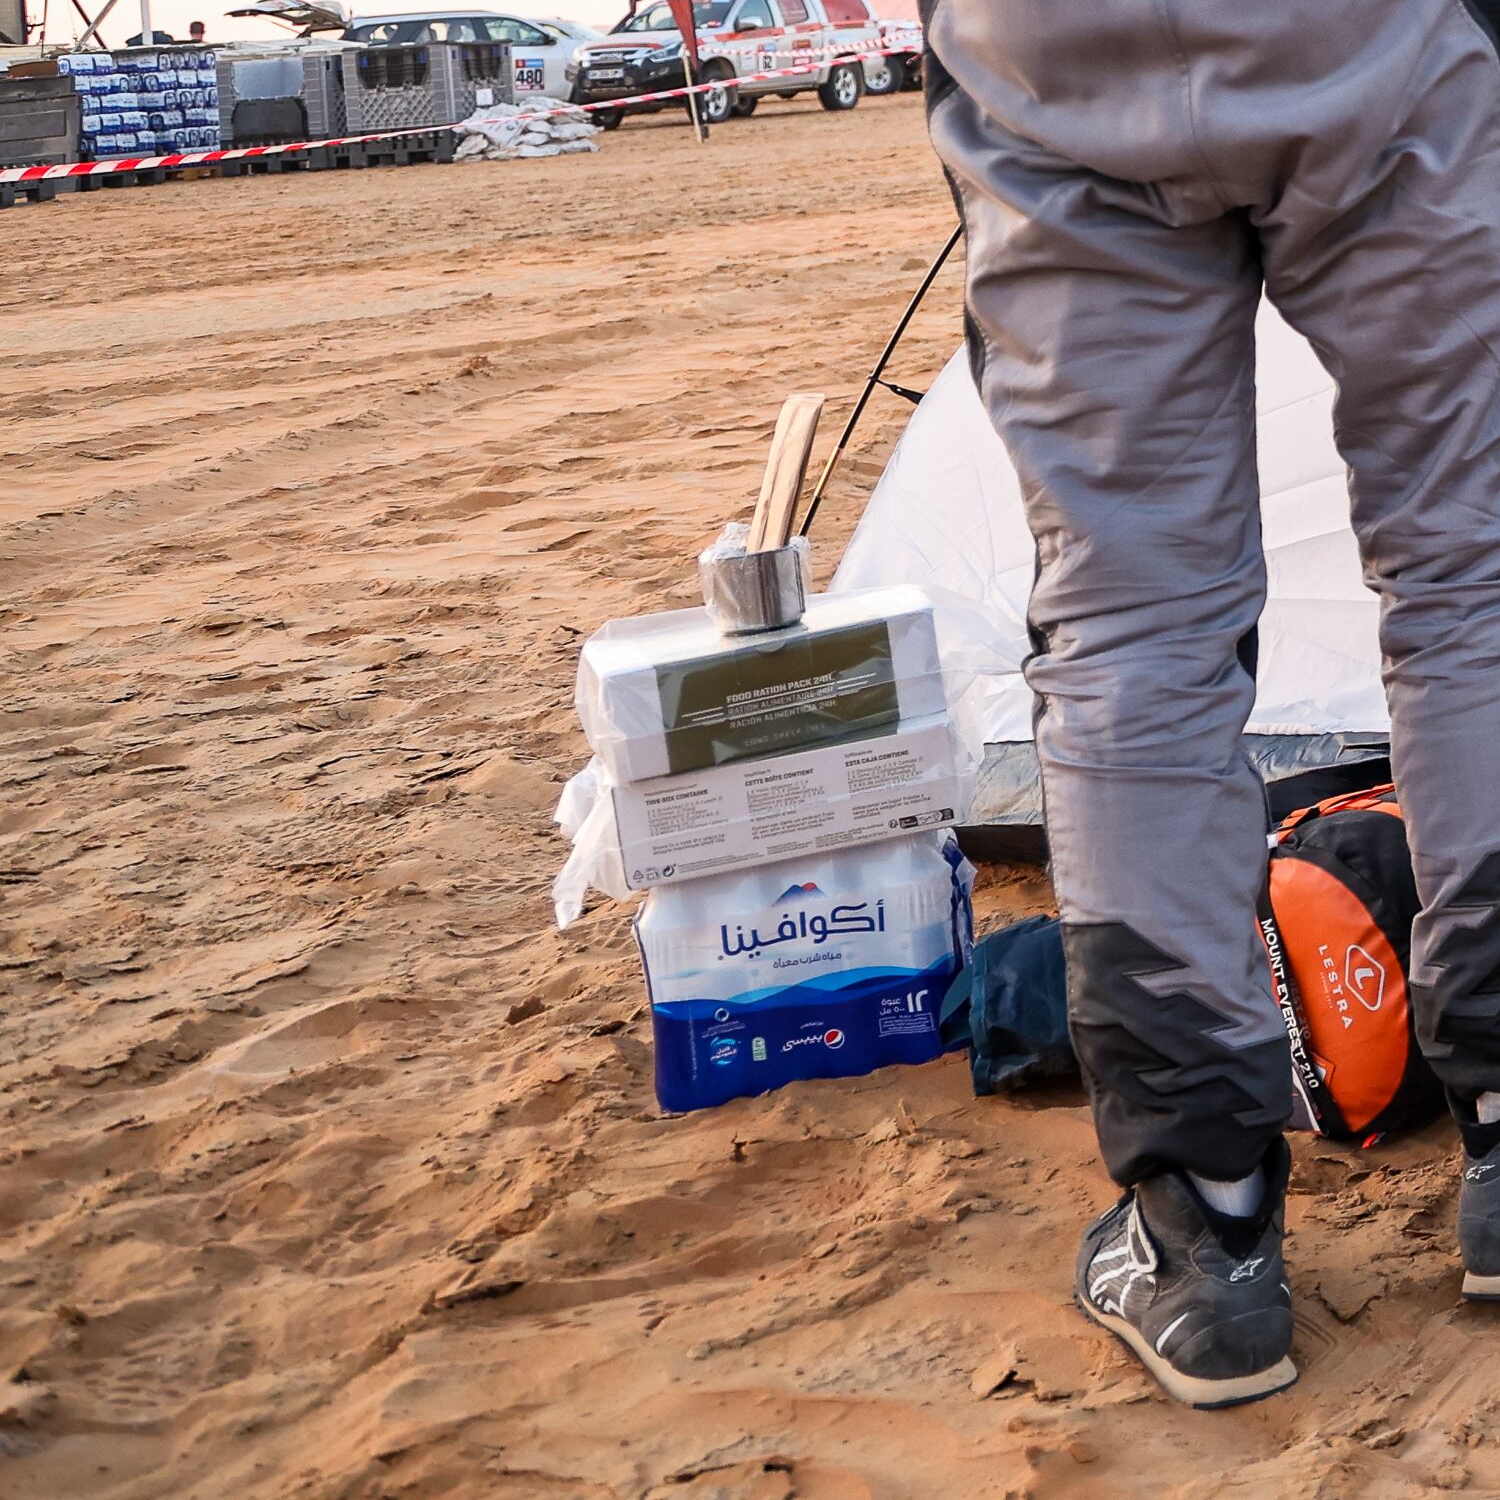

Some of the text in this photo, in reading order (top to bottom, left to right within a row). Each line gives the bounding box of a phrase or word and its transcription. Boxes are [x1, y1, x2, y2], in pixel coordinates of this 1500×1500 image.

[515, 69, 543, 85] 480
[726, 689, 752, 703] FOOD
[753, 684, 787, 697] RATION
[788, 678, 812, 690] PACK
[727, 703, 759, 714] RATION
[861, 756, 878, 764] CAJA
[878, 749, 909, 761] CONTIENE
[744, 778, 764, 787] CETTE
[783, 768, 814, 780] CONTIENT
[675, 788, 708, 801] CONTAINS
[720, 899, 885, 959] أكوافينا
[1318, 944, 1353, 1029] LESTRA
[906, 989, 929, 1013] ١٢
[1260, 918, 1320, 1090] MOUNT EVEREST 210
